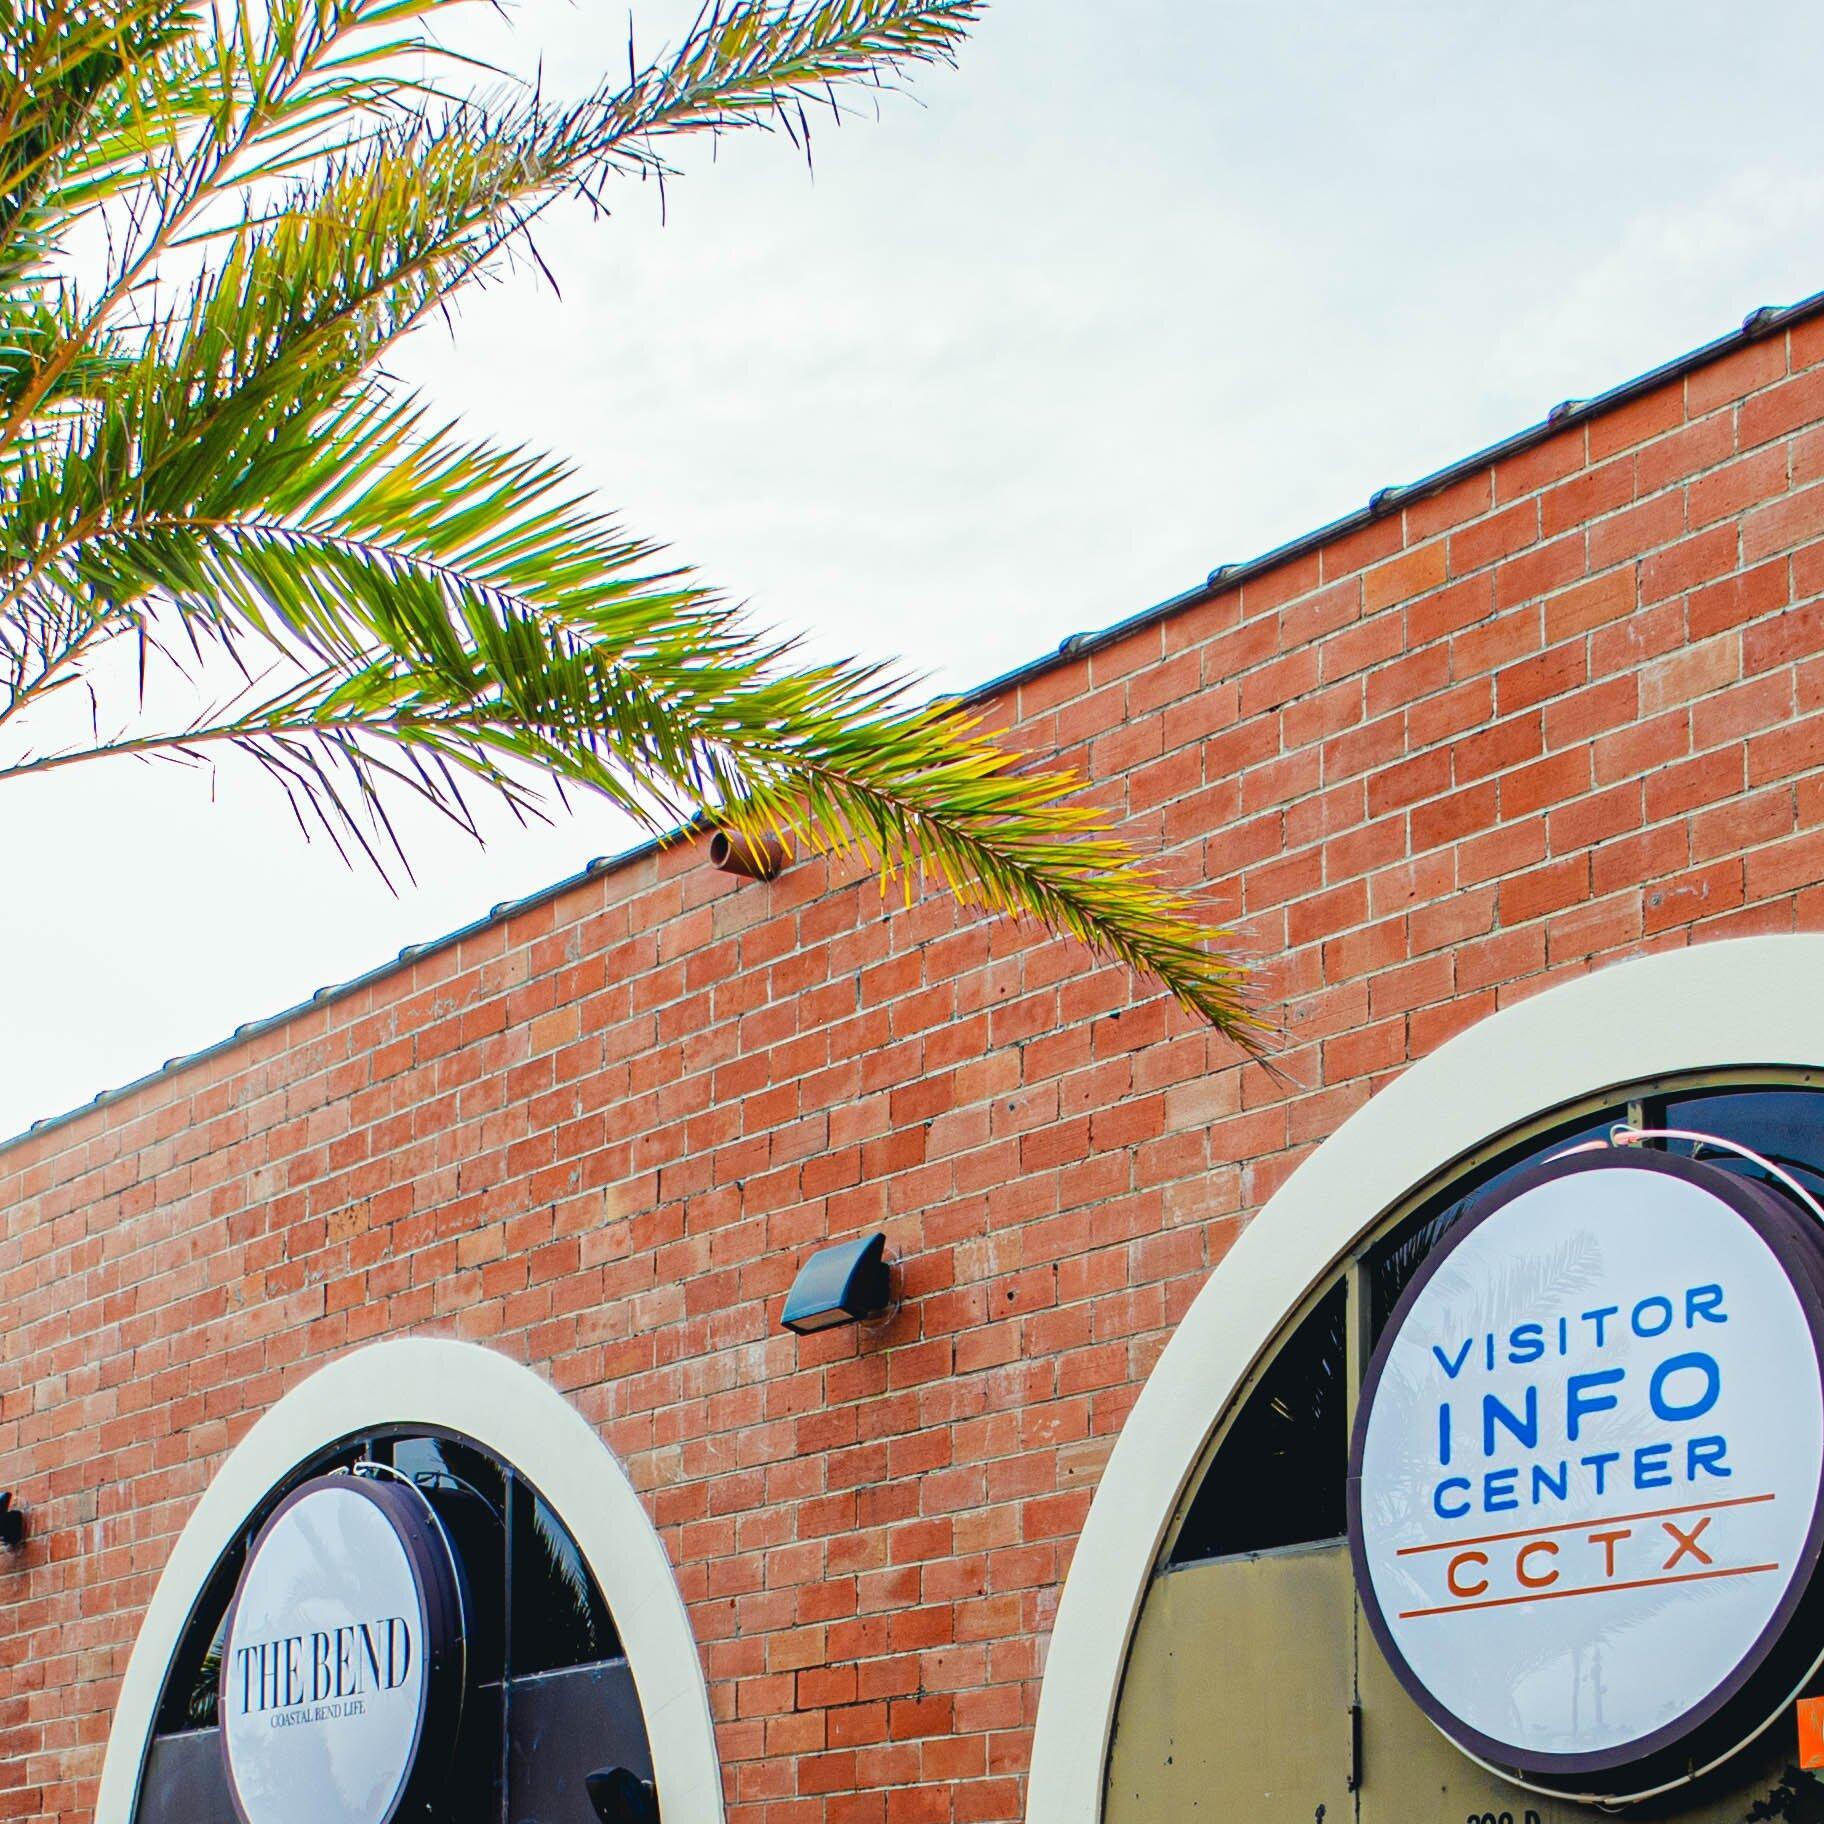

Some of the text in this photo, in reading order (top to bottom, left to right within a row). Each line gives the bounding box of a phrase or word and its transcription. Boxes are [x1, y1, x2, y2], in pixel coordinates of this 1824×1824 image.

[1433, 1282, 1729, 1380] VISITOR
[1438, 1350, 1722, 1464] INFO
[1433, 1434, 1733, 1520] CENTER
[1447, 1516, 1713, 1599] CCTX
[238, 1616, 411, 1715] THE BEND
[270, 1700, 366, 1729] COASTAL BEND LIFE
